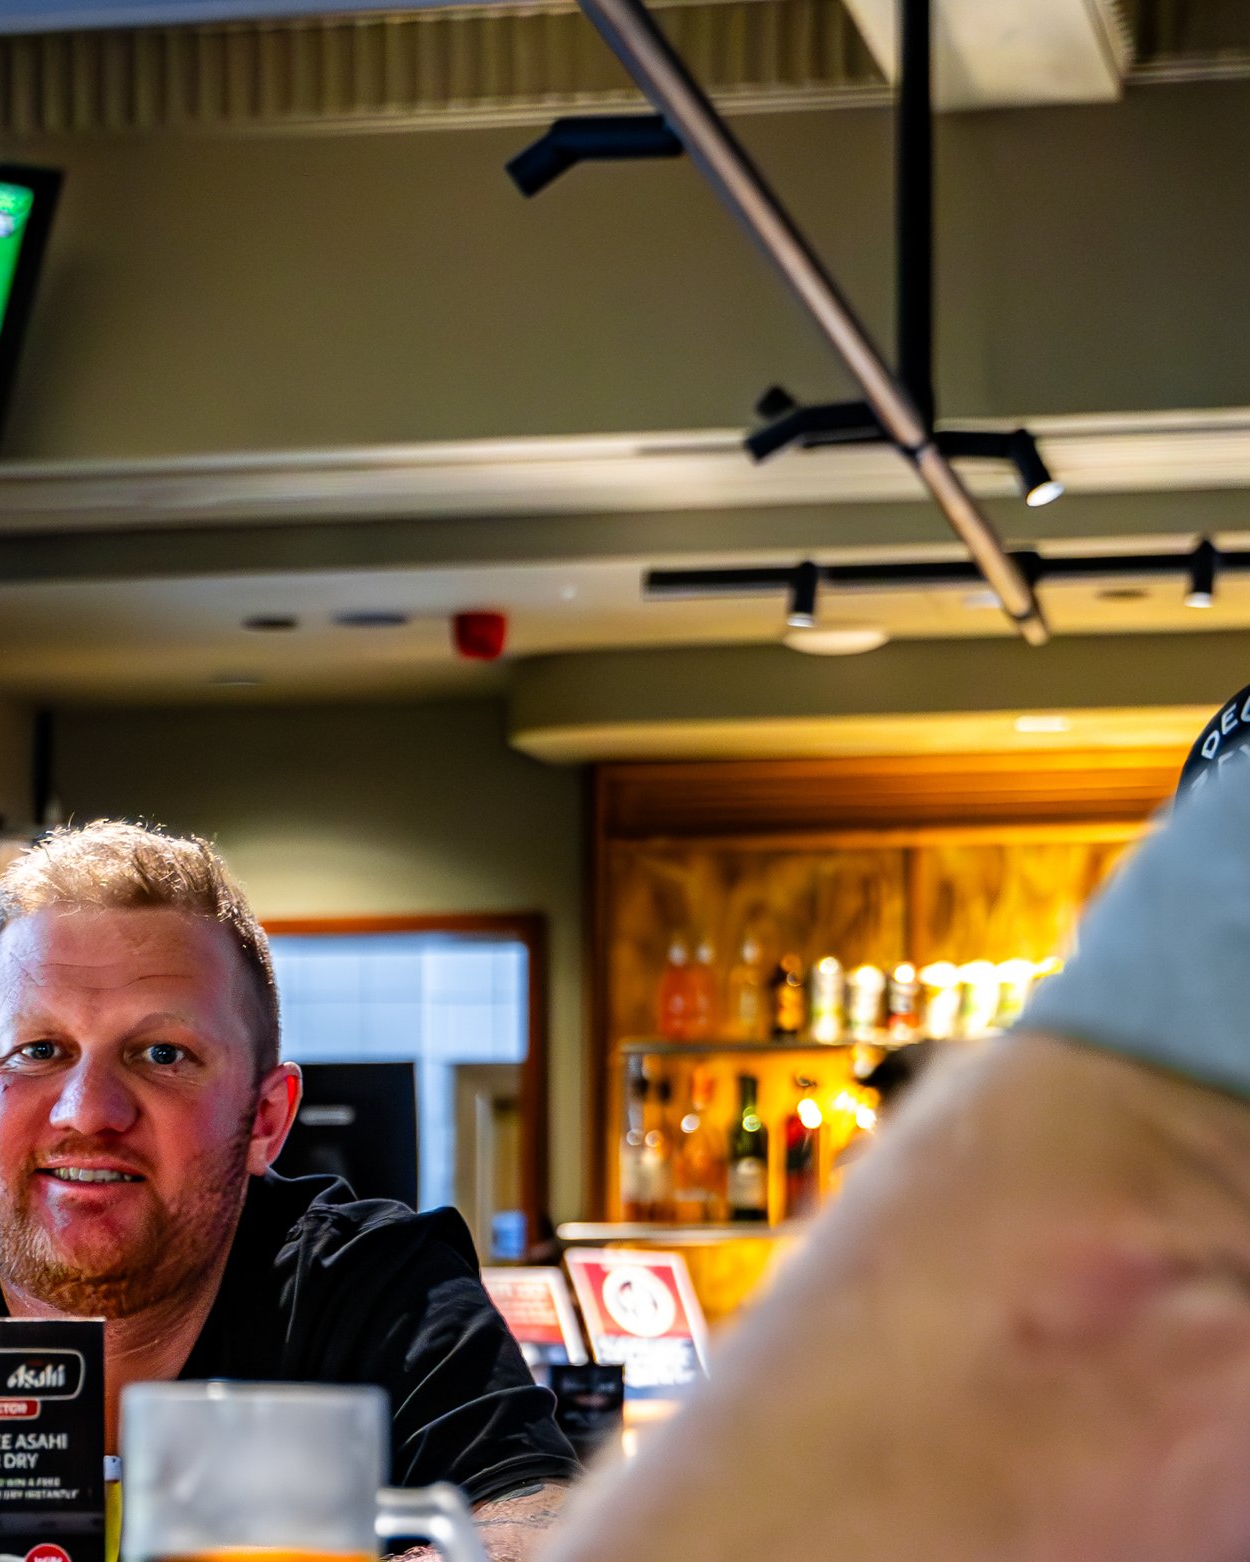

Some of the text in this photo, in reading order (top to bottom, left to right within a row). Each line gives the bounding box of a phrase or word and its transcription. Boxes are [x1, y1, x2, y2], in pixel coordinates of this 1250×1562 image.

[6, 1363, 66, 1389] Asahi
[15, 1433, 68, 1450] ASAHI
[3, 1452, 40, 1469] DRY
